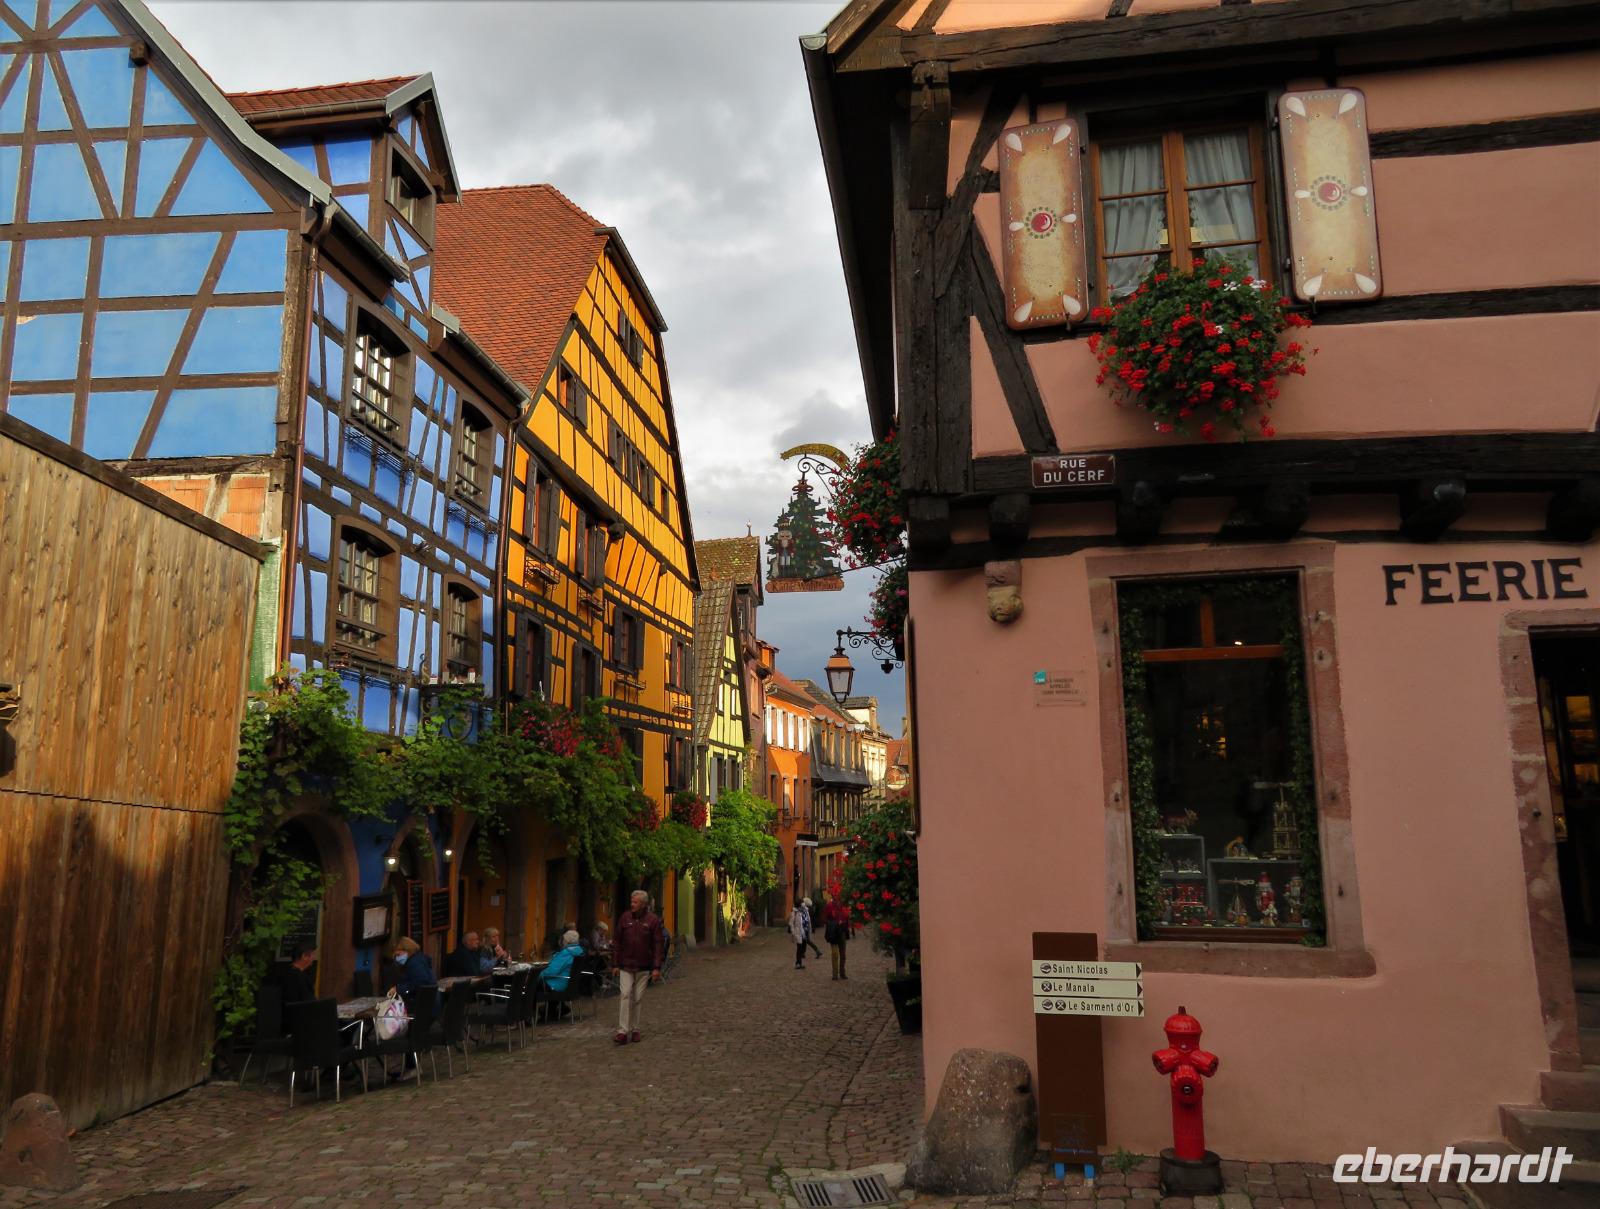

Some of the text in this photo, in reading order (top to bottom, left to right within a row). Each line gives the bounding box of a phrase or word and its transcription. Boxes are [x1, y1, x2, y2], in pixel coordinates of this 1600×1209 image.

[1060, 459, 1086, 469] RUE
[1043, 470, 1105, 483] DU CERF
[1382, 557, 1589, 606] FEERIE
[1052, 964, 1108, 975] Saint Nicolas
[1053, 982, 1063, 992] Le
[1068, 1001, 1134, 1013] Le Sarment d'Or
